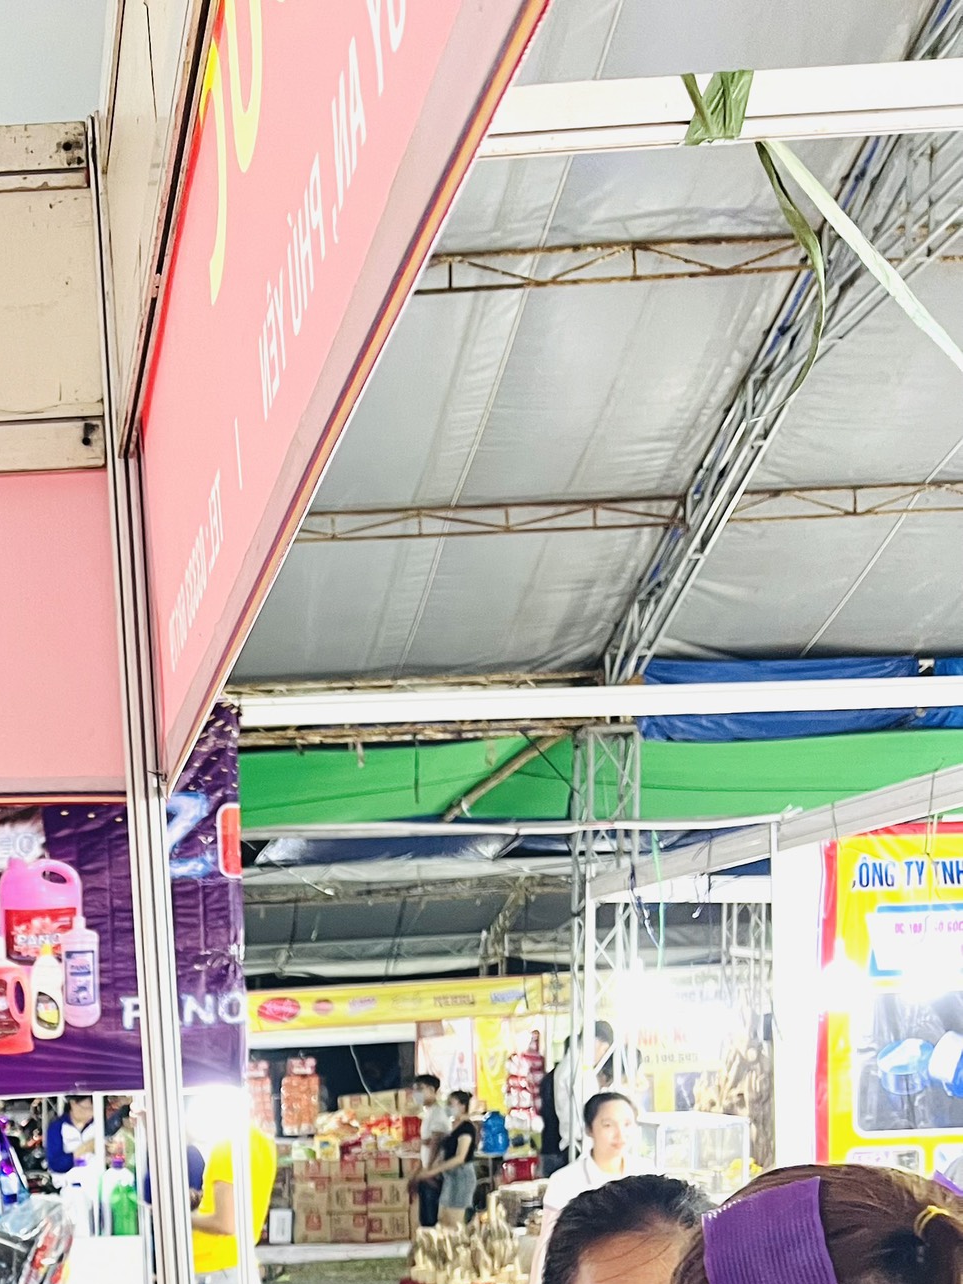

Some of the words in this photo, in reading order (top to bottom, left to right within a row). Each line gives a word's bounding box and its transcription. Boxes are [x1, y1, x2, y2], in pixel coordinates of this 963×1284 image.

[852, 856, 895, 889] ÔNG
[904, 860, 925, 887] TY
[120, 991, 248, 1031] PNO
